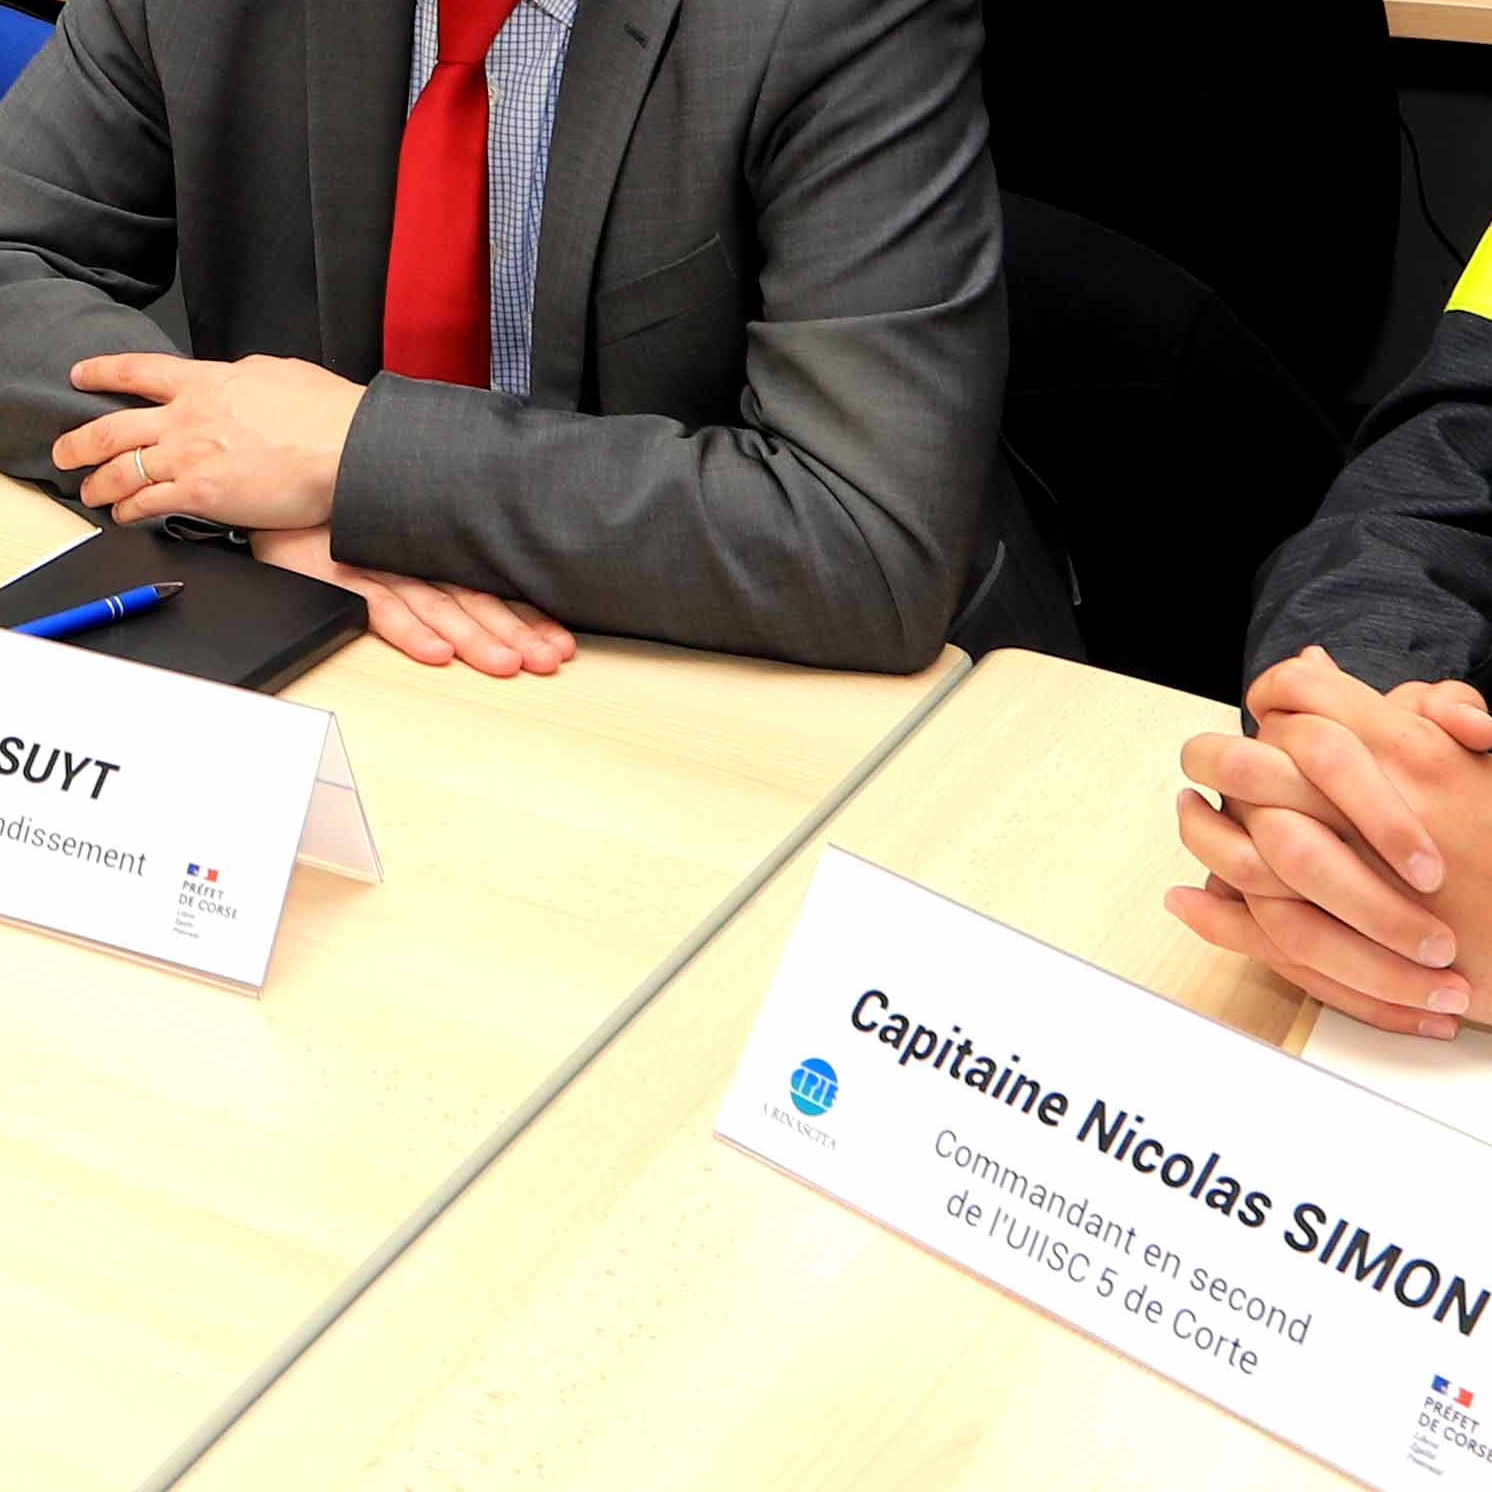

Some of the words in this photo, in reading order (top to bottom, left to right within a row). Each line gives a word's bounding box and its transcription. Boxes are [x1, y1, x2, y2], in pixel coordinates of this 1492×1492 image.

[178, 892, 194, 908] DE
[197, 899, 238, 920] CORSE
[182, 879, 225, 901] PRÉFET
[849, 988, 1070, 1128] Capitaine
[1076, 1097, 1273, 1230] Nicolas
[1283, 1200, 1492, 1337] SIMON
[933, 1127, 1137, 1256] Commandant
[1143, 1233, 1181, 1275] en
[1189, 1254, 1313, 1346] second
[946, 1186, 982, 1227] de
[985, 1206, 1091, 1286] l'UIISC
[1096, 1264, 1118, 1298] 5
[1122, 1277, 1165, 1323] de
[1171, 1300, 1260, 1376] Corte
[1417, 1411, 1441, 1434] DE
[1423, 1395, 1481, 1434] PRÉFET
